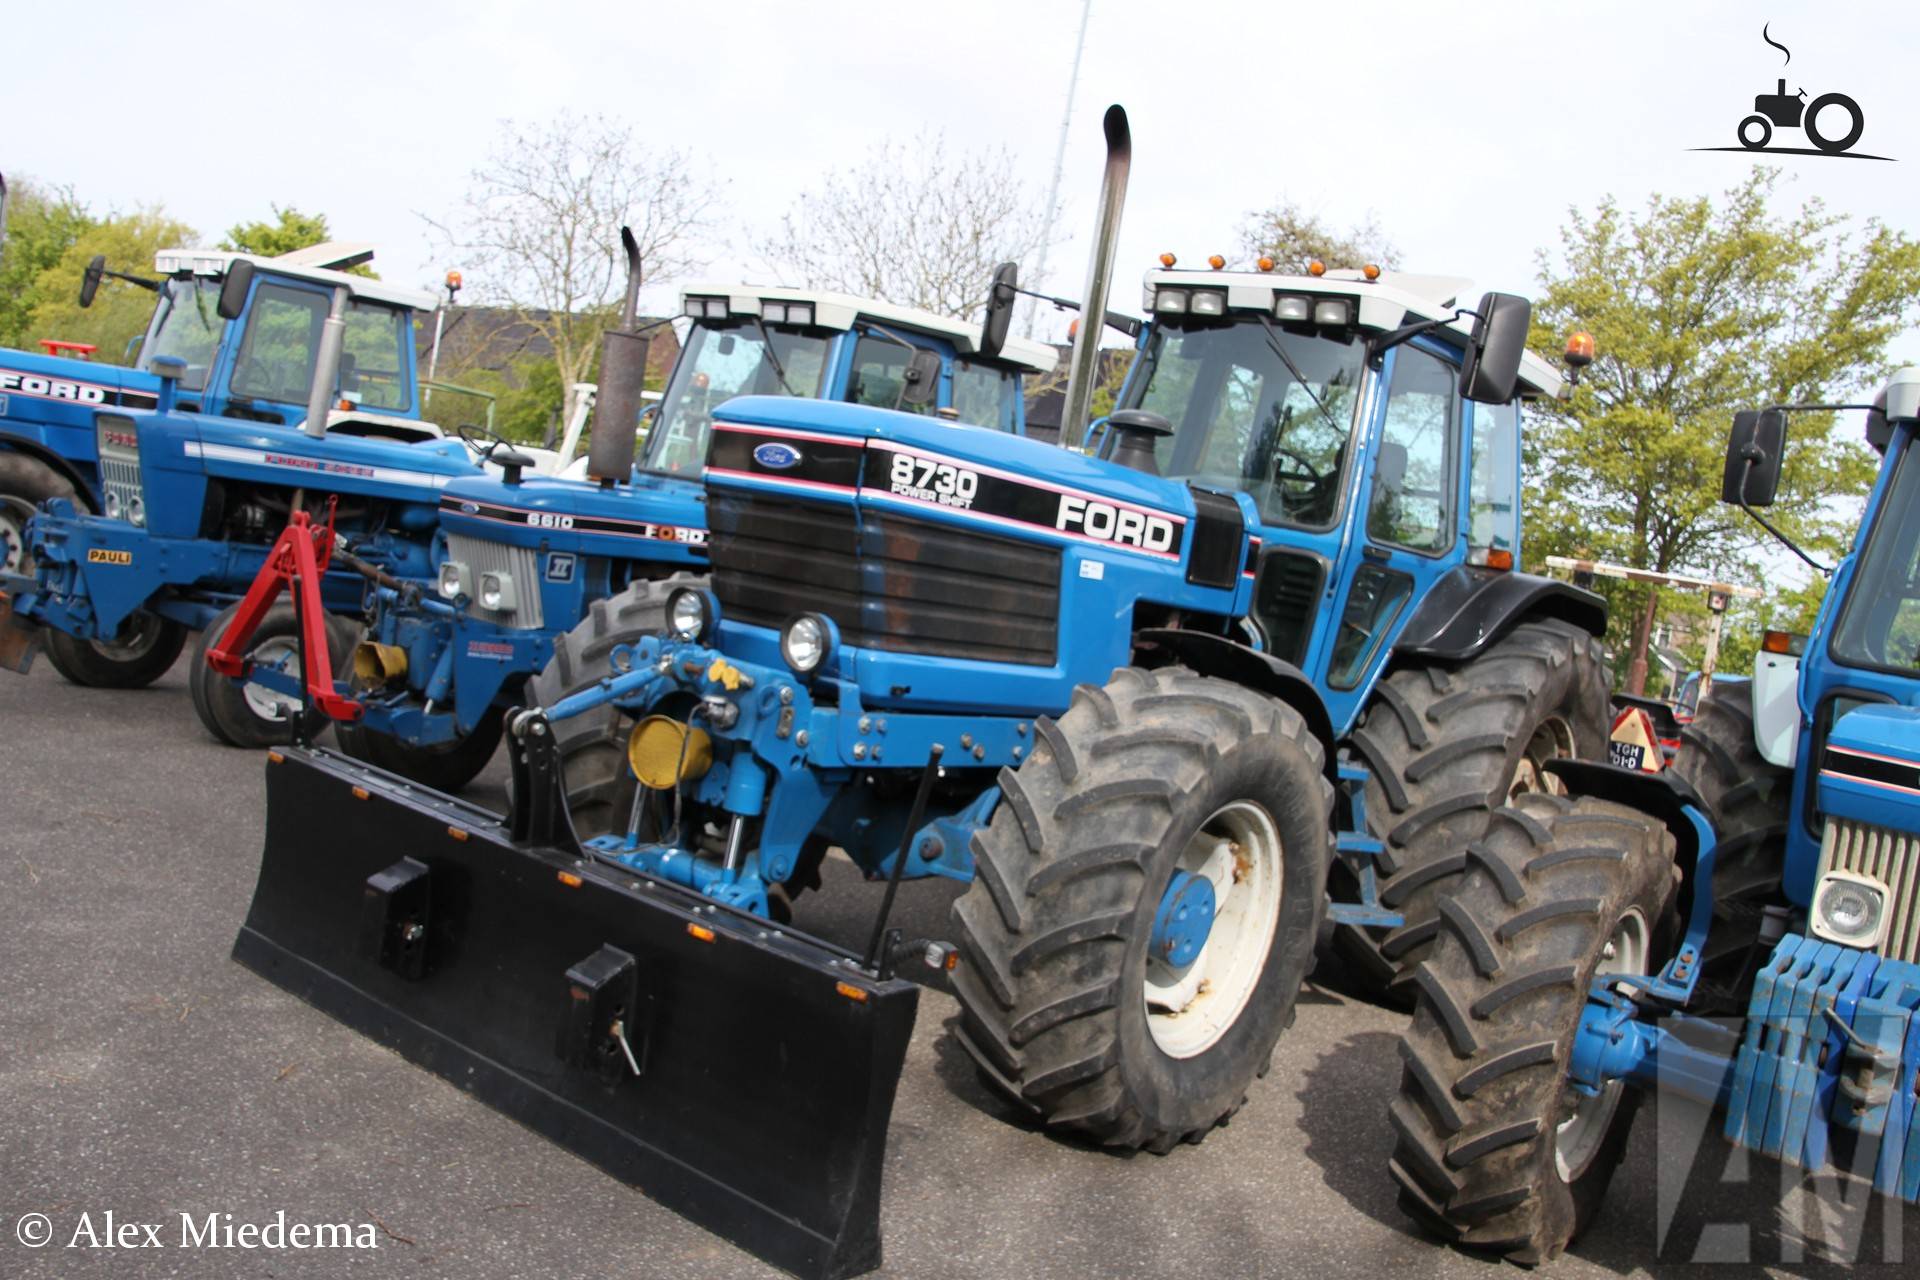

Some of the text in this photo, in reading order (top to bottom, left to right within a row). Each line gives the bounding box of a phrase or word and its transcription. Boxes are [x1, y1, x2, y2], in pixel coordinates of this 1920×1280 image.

[0, 373, 105, 403] FORD
[891, 453, 978, 500] 8730
[891, 482, 973, 509] POWER SHIFT
[527, 512, 574, 529] 6610
[1056, 494, 1174, 553] FORD
[645, 524, 704, 544] FORD
[90, 551, 130, 564] PAULI
[1616, 743, 1639, 758] TGH
